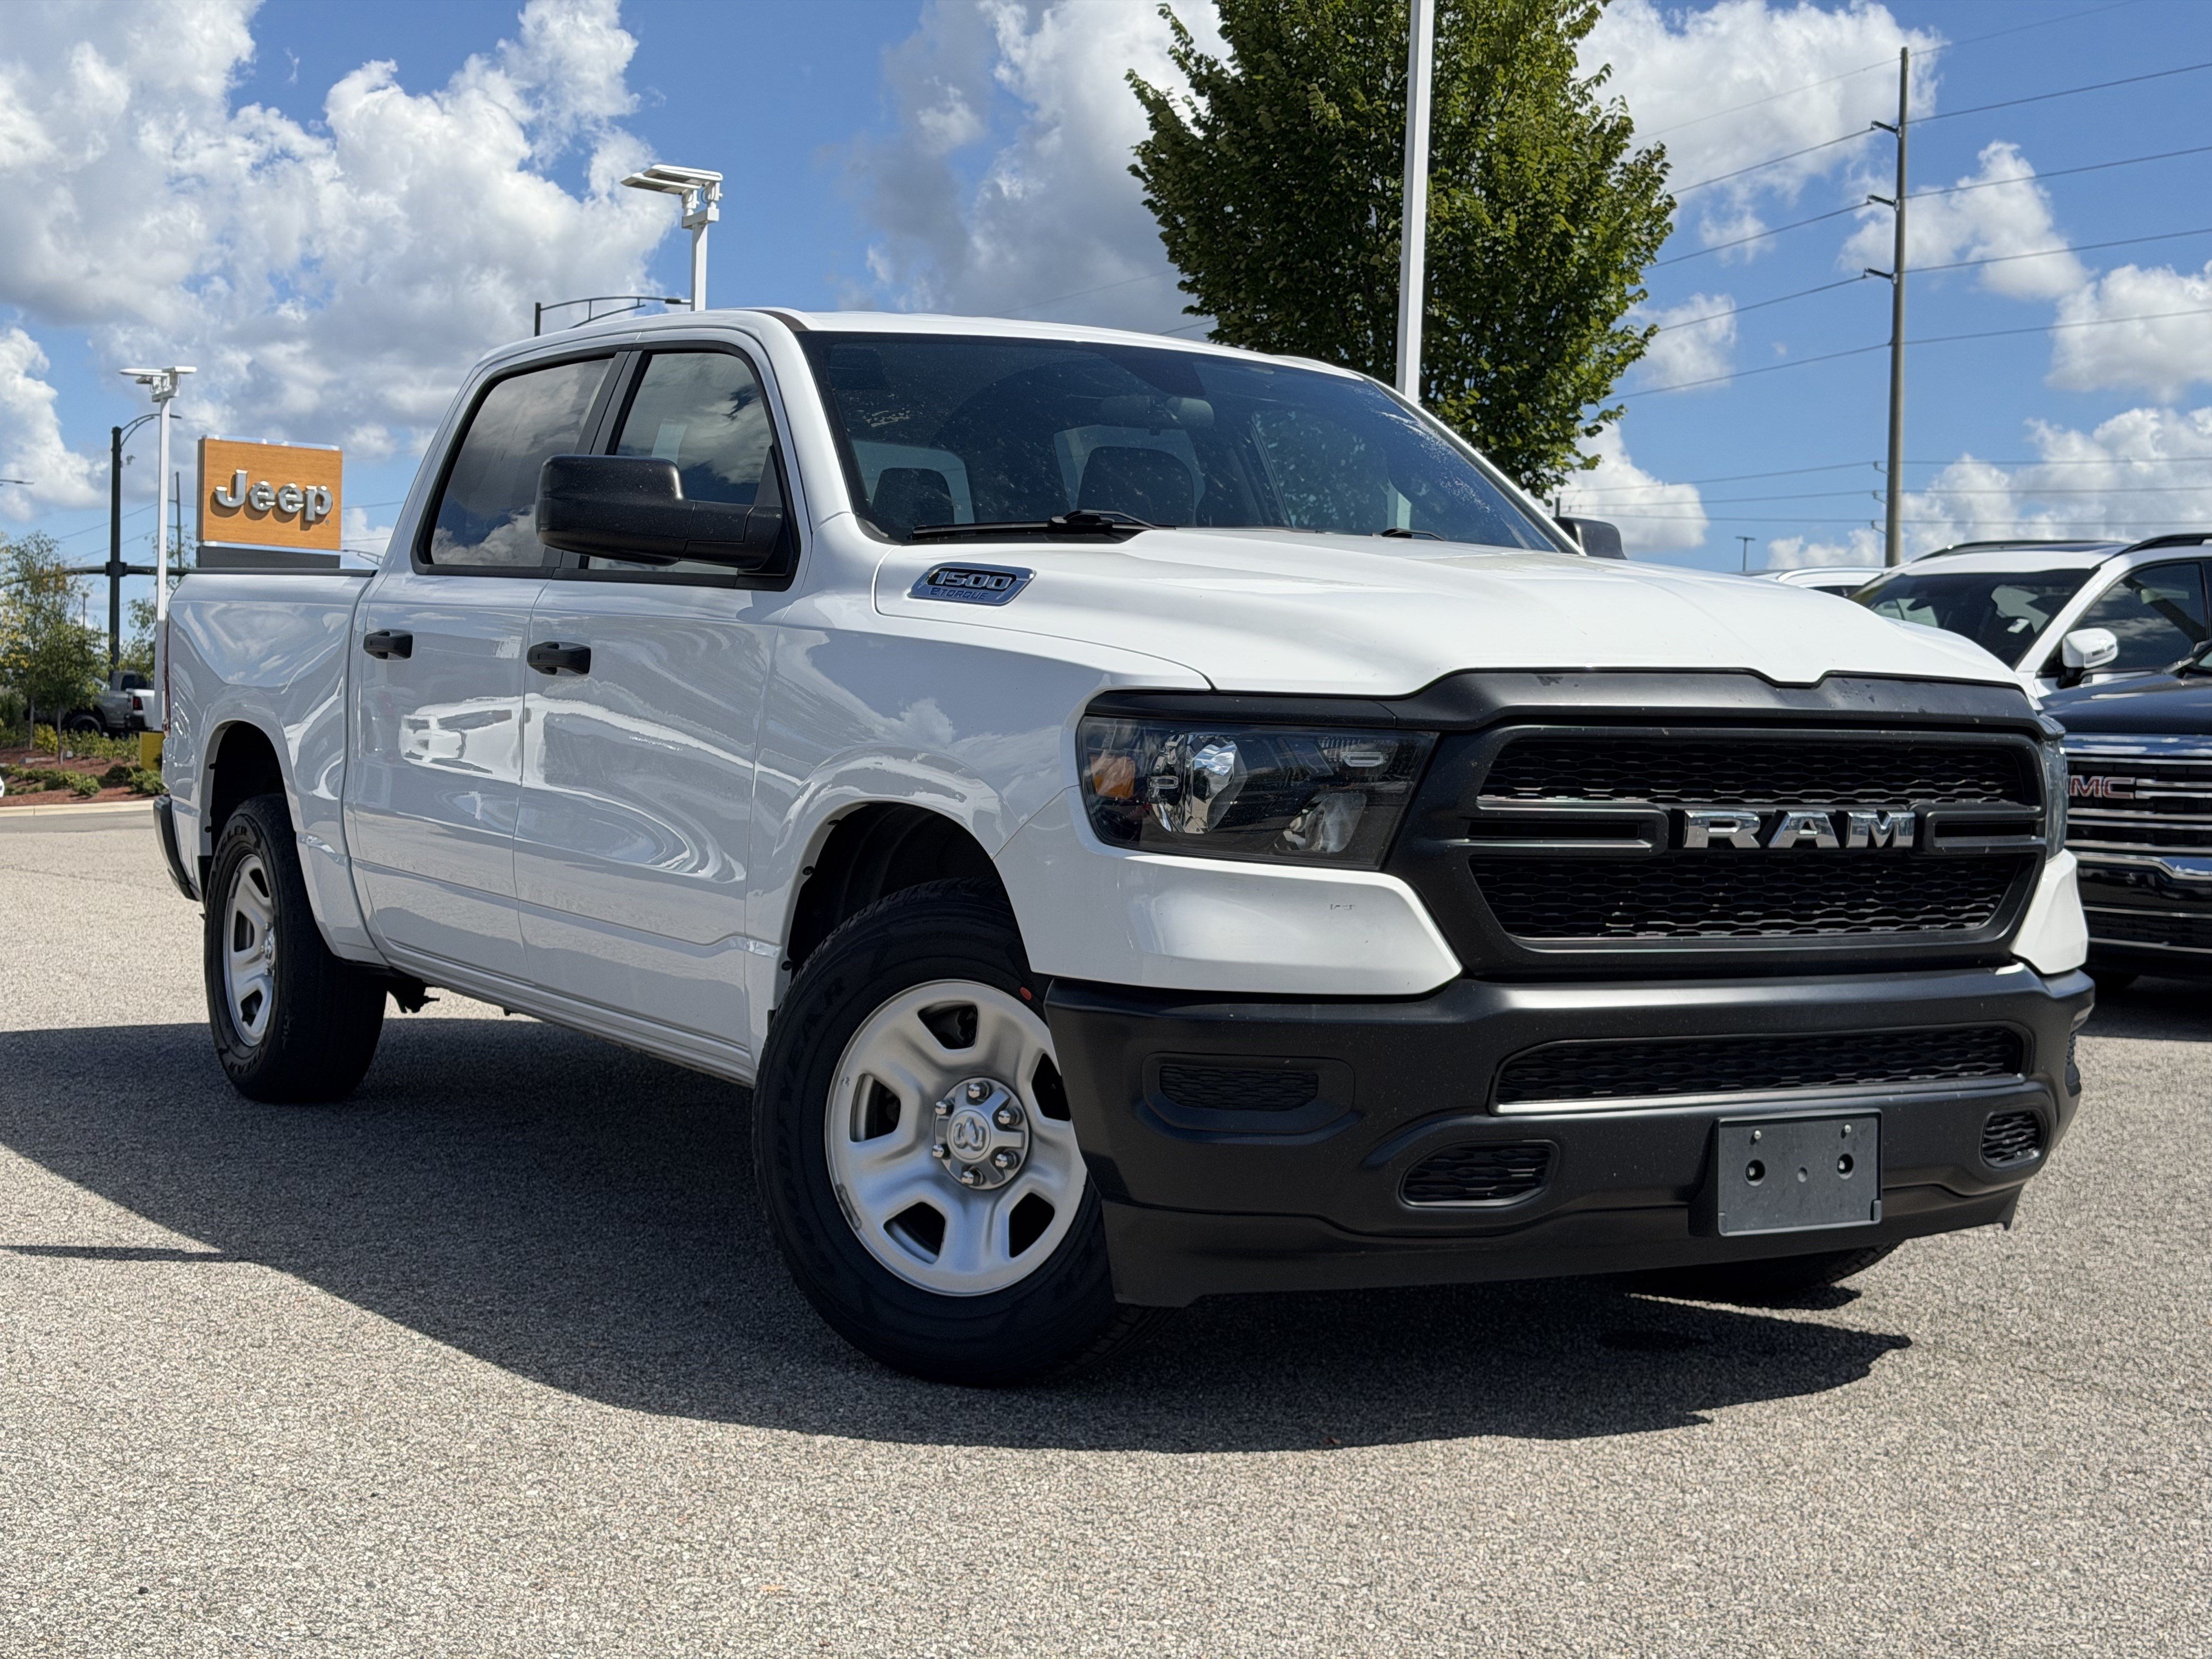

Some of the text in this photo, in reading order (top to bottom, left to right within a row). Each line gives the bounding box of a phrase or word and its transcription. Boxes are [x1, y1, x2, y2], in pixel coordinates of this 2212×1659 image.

[215, 469, 333, 522] Jeep
[935, 572, 1012, 590] 1500
[2070, 775, 2135, 799] MC
[1683, 810, 1915, 849] RAM
